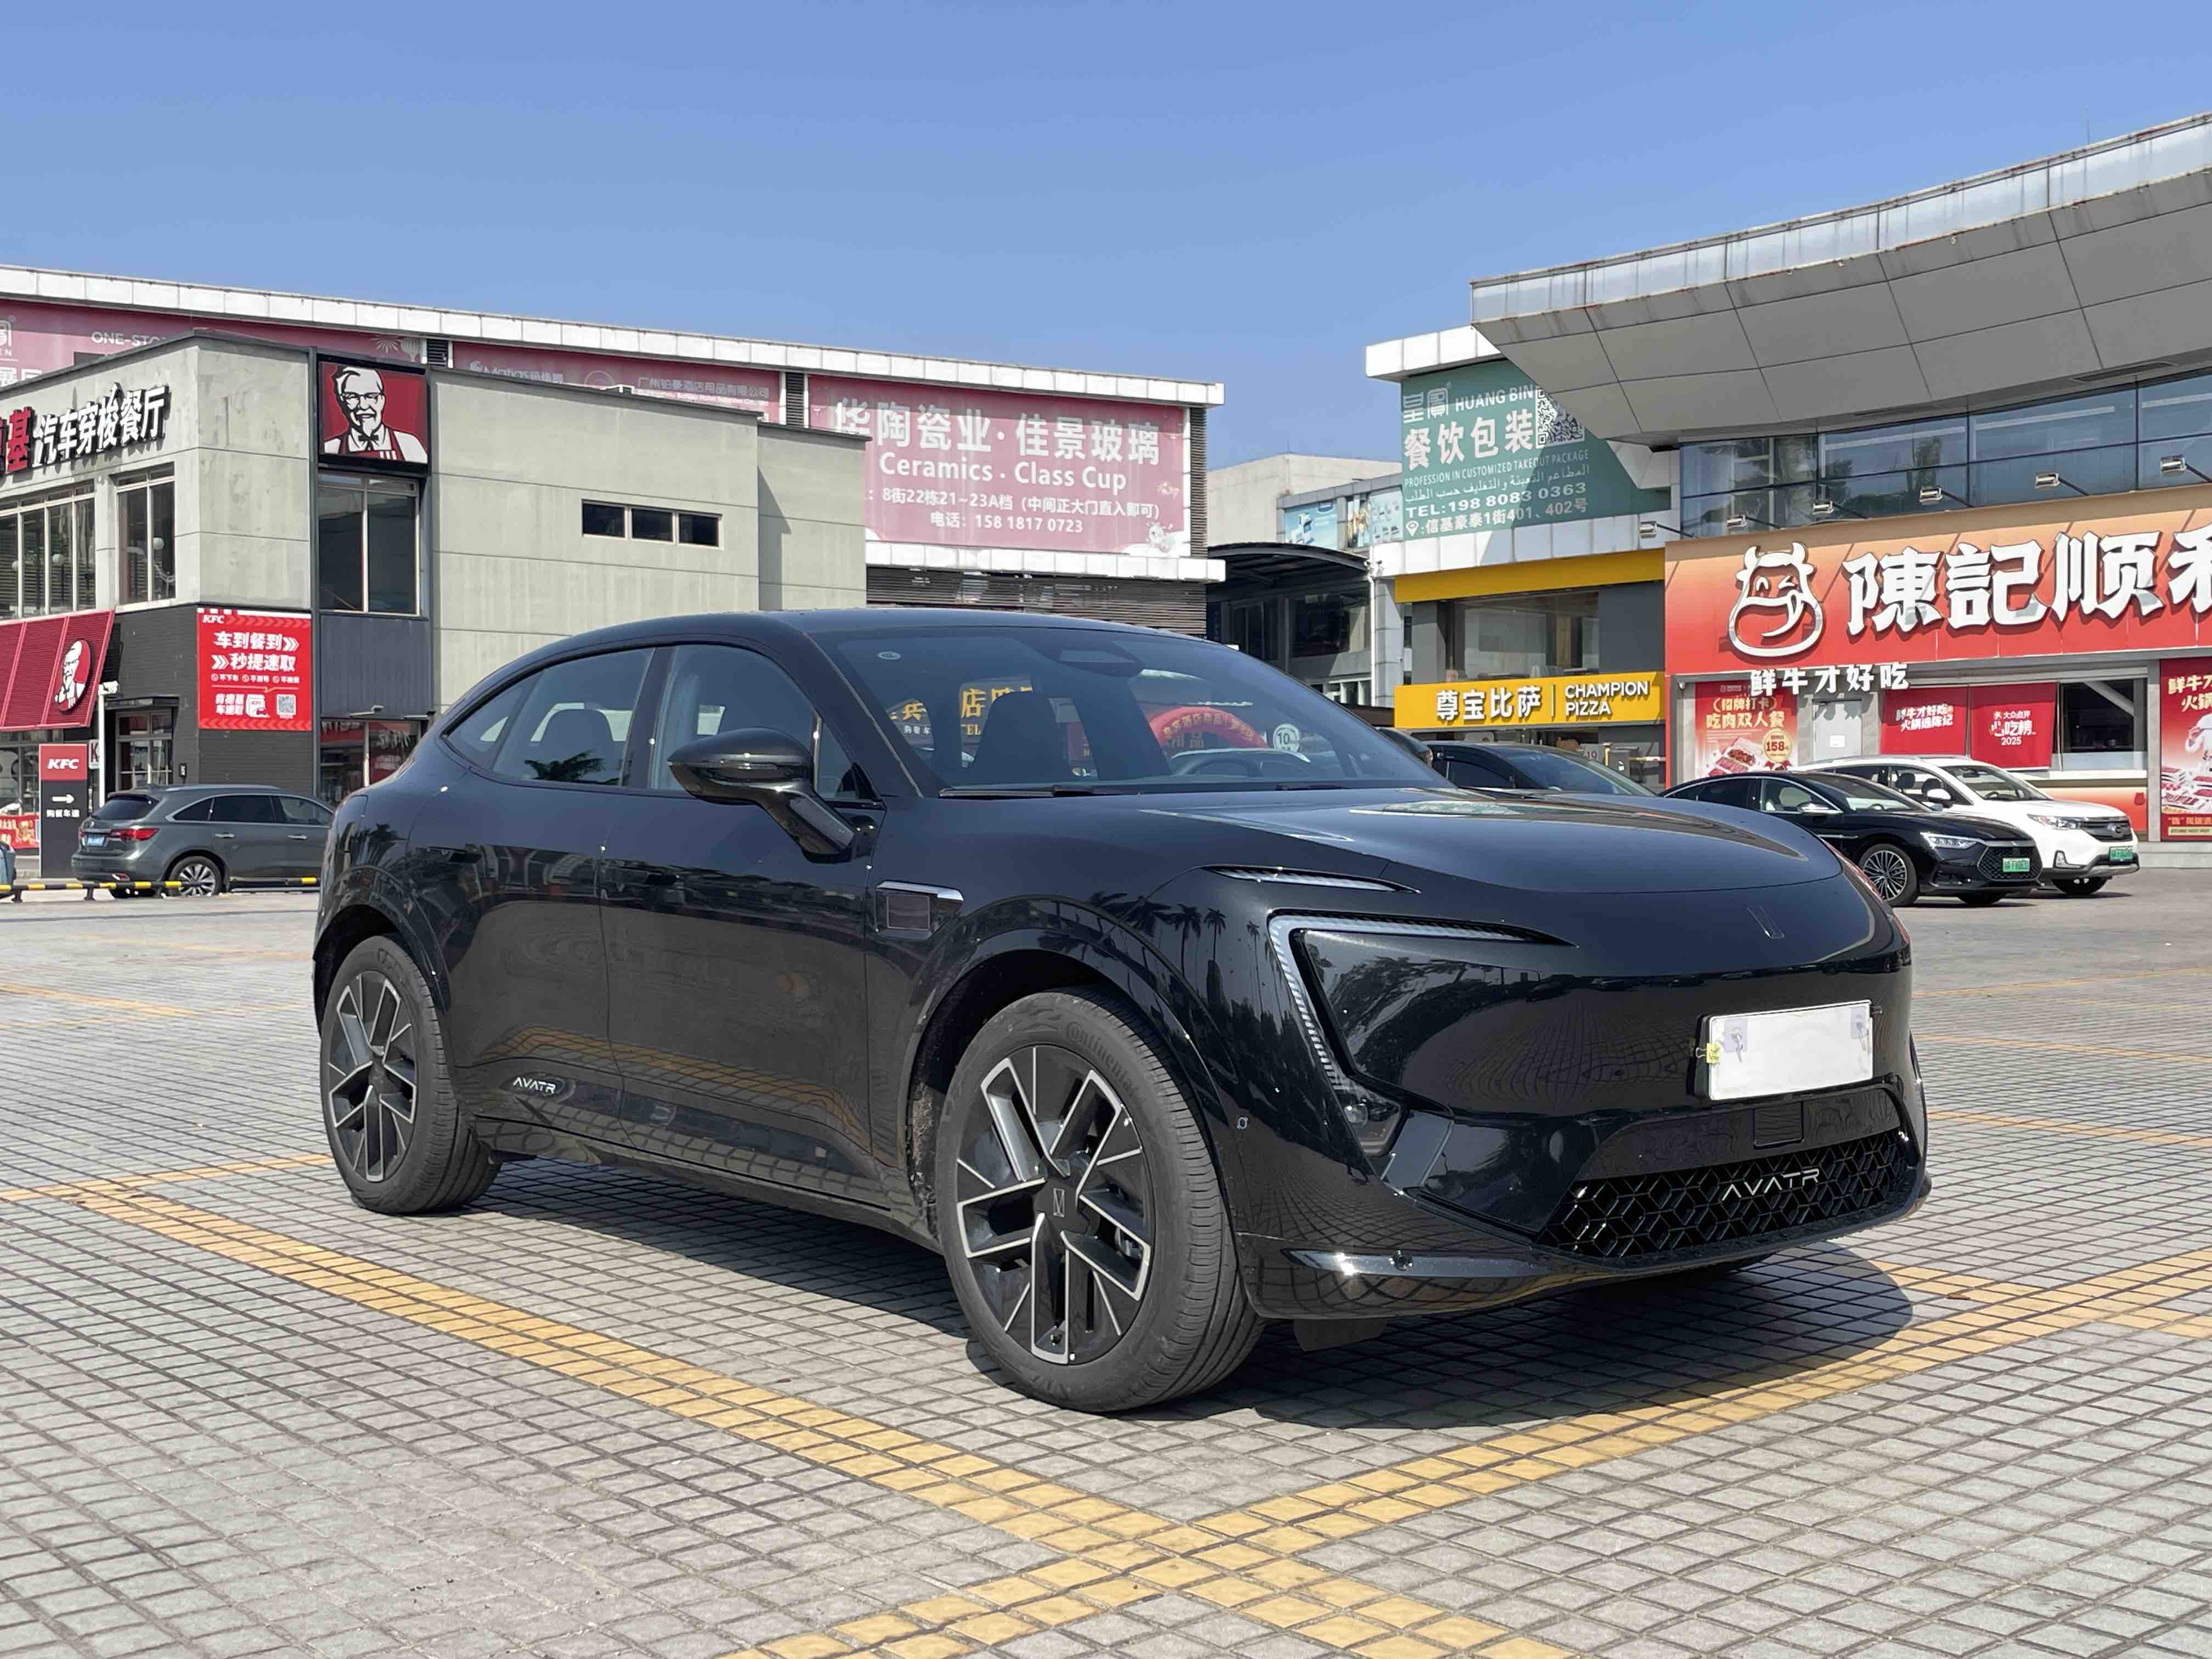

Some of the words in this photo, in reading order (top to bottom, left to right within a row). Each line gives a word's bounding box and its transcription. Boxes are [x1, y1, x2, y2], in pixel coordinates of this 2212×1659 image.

[1454, 388, 1506, 412] HUANG
[1509, 384, 1534, 402] BIN
[32, 382, 168, 468] 汽车穿梭餐厅
[1403, 408, 1534, 472] 餐饮包装
[879, 452, 994, 483] Ceramics
[1014, 460, 1075, 488] Class
[1081, 466, 1127, 496] Cup
[1404, 471, 1451, 488] PROFESSION
[1452, 470, 1460, 481] IN
[1462, 461, 1512, 479] CUSTOMIZED
[1514, 455, 1550, 471] TAKEOUT
[1551, 449, 1589, 464] PACKAGE
[1485, 489, 1532, 507] 8083
[1538, 482, 1587, 499] 0363
[1007, 516, 1042, 531] 1817
[1047, 518, 1084, 533] 0723
[203, 614, 225, 624] KFC
[213, 631, 283, 651] 车到餐到
[229, 652, 296, 672] 秒提速取
[1751, 662, 1909, 697] 鲜牛才好吃
[1565, 681, 1649, 700] CHAMPION
[1436, 686, 1541, 721] 尊宝比萨
[1565, 700, 1611, 716] PIZZA
[1706, 711, 1785, 729] 吃肉双人餐
[2001, 736, 2023, 746] 2025
[47, 759, 80, 770] KFC
[512, 1076, 556, 1094] AVATR
[1721, 1169, 1820, 1201] AVATR
